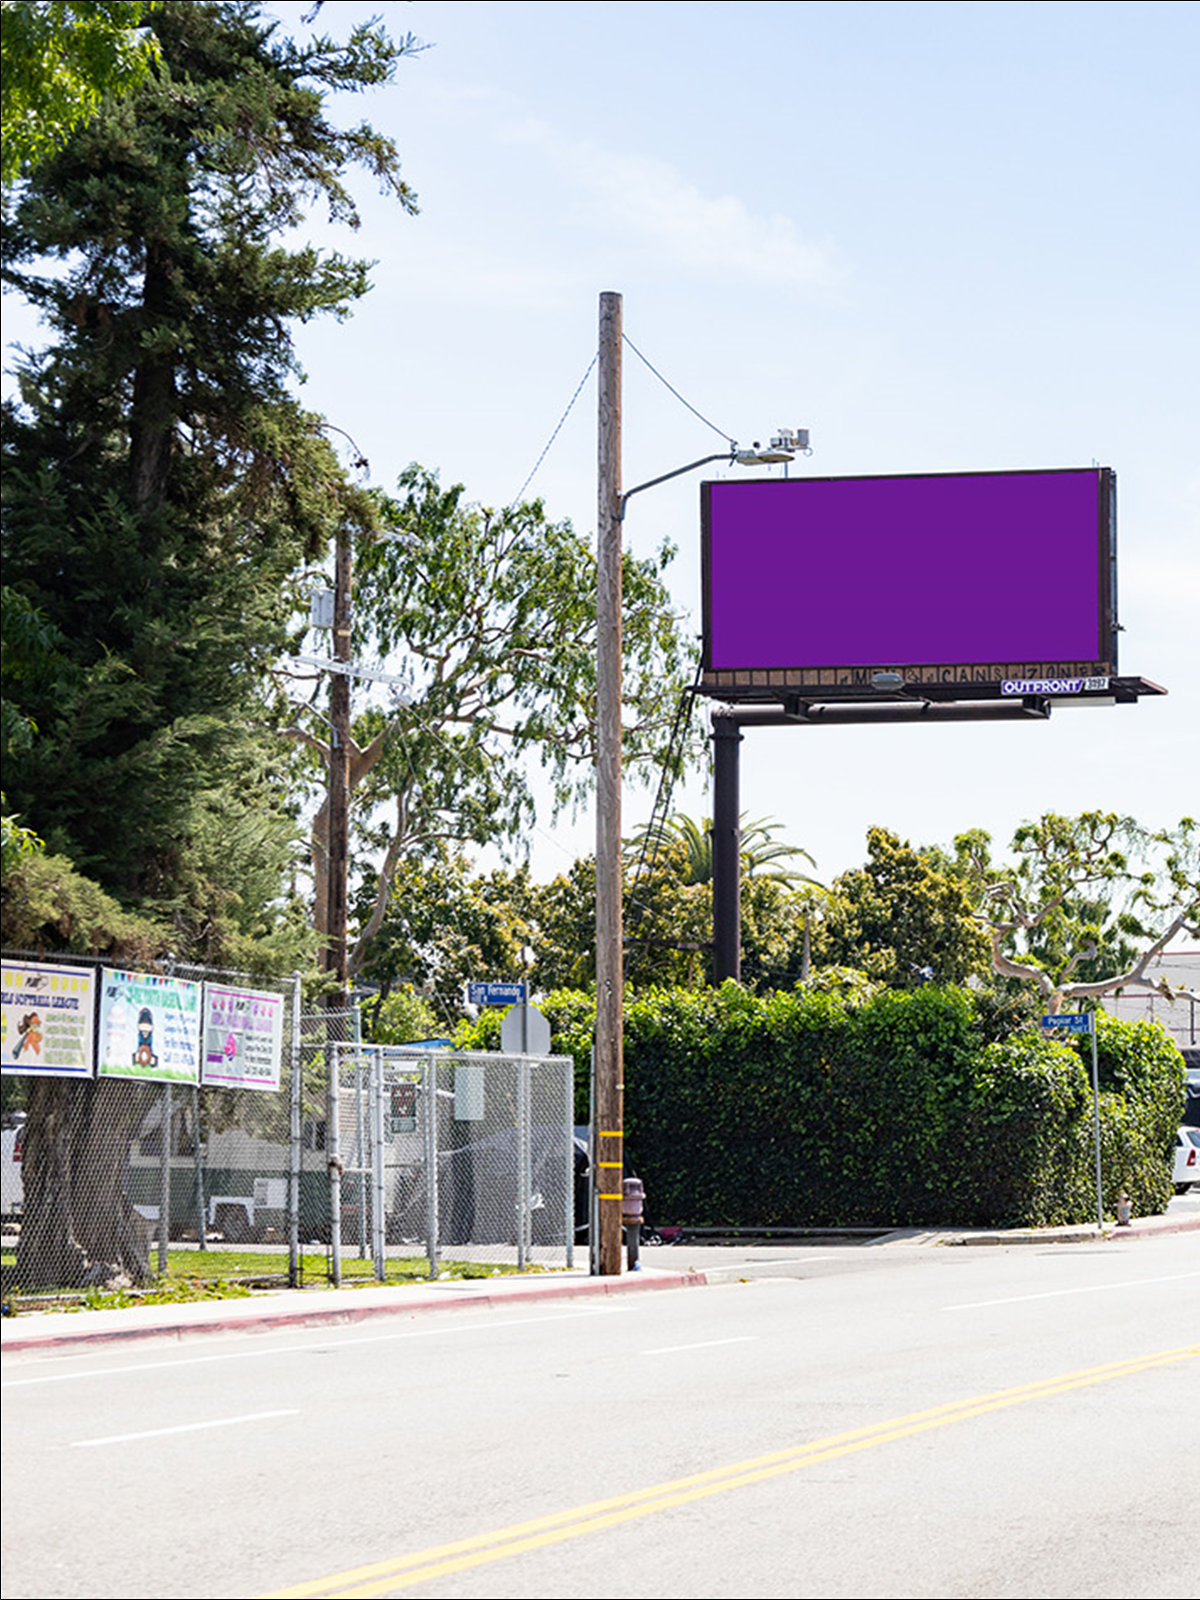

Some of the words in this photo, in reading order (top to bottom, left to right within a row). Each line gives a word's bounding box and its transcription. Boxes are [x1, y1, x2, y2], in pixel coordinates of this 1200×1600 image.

[1004, 680, 1080, 694] OUTFRONT
[471, 985, 485, 995] San
[488, 984, 520, 996] Fernando
